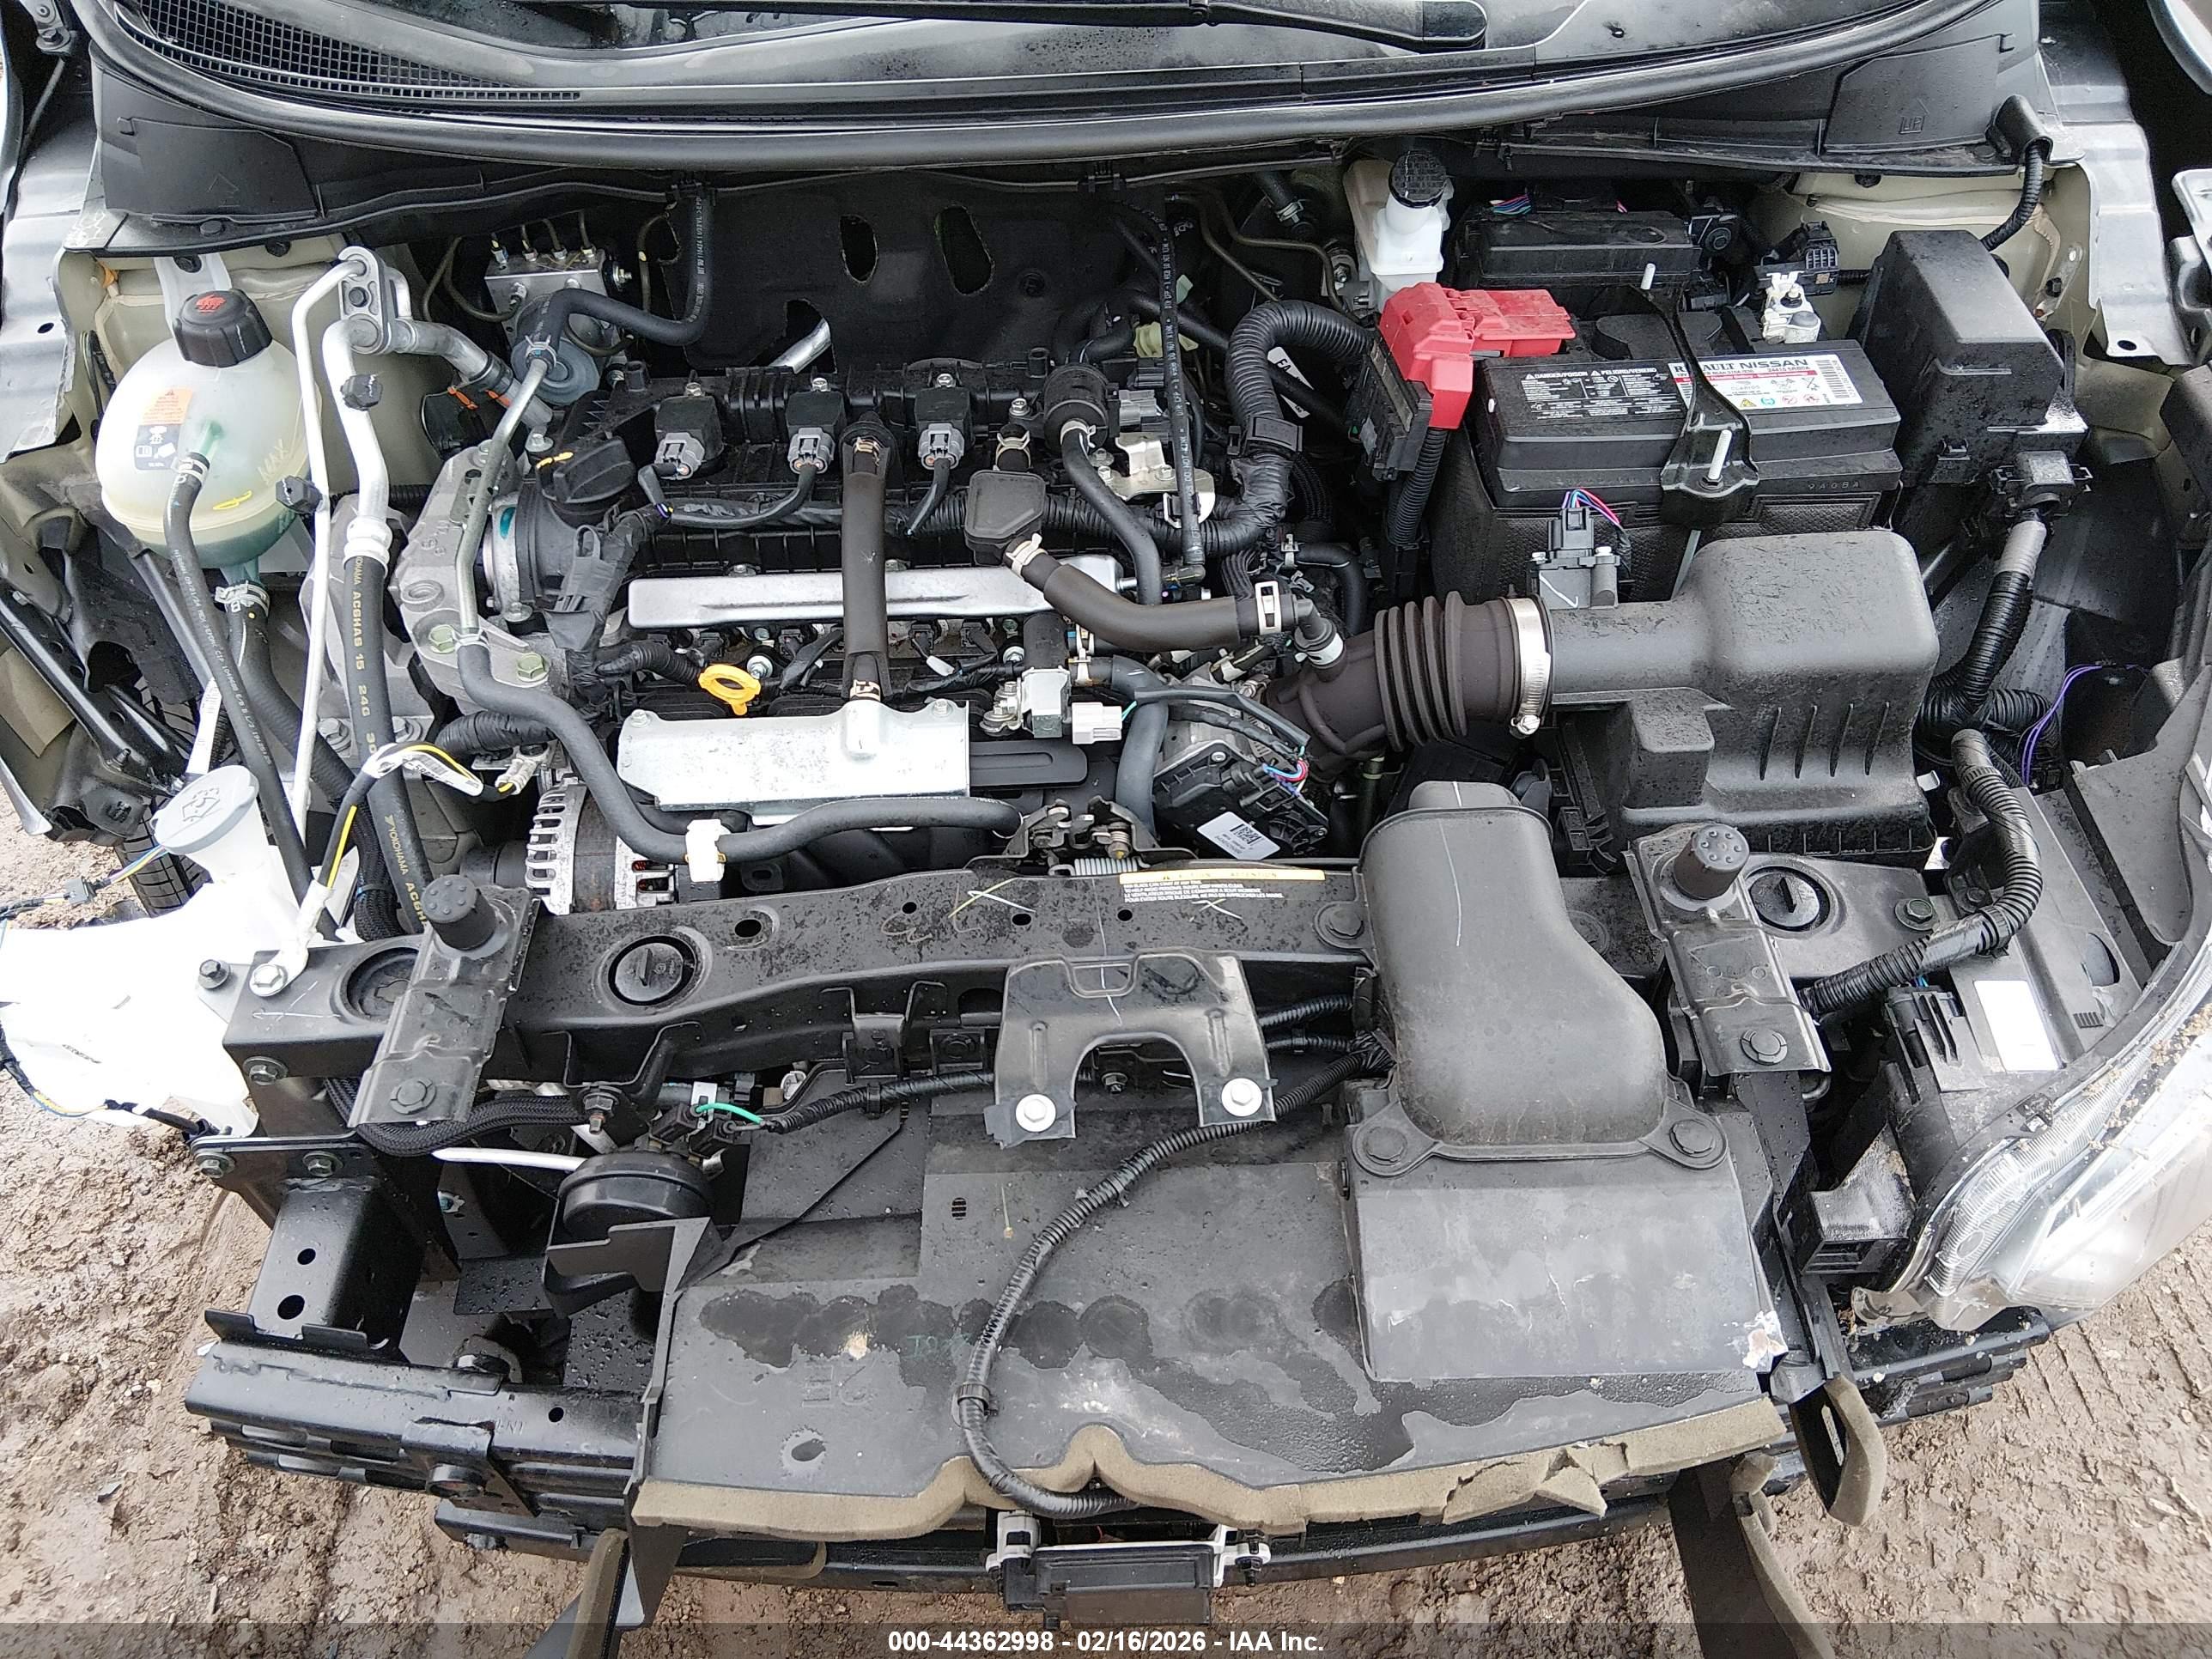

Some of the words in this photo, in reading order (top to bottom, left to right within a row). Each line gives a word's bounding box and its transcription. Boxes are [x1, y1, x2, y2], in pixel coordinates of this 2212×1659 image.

[1740, 359, 1809, 369] NISSAN
[355, 653, 366, 671] 15
[388, 827, 410, 876] YOKOHAMA
